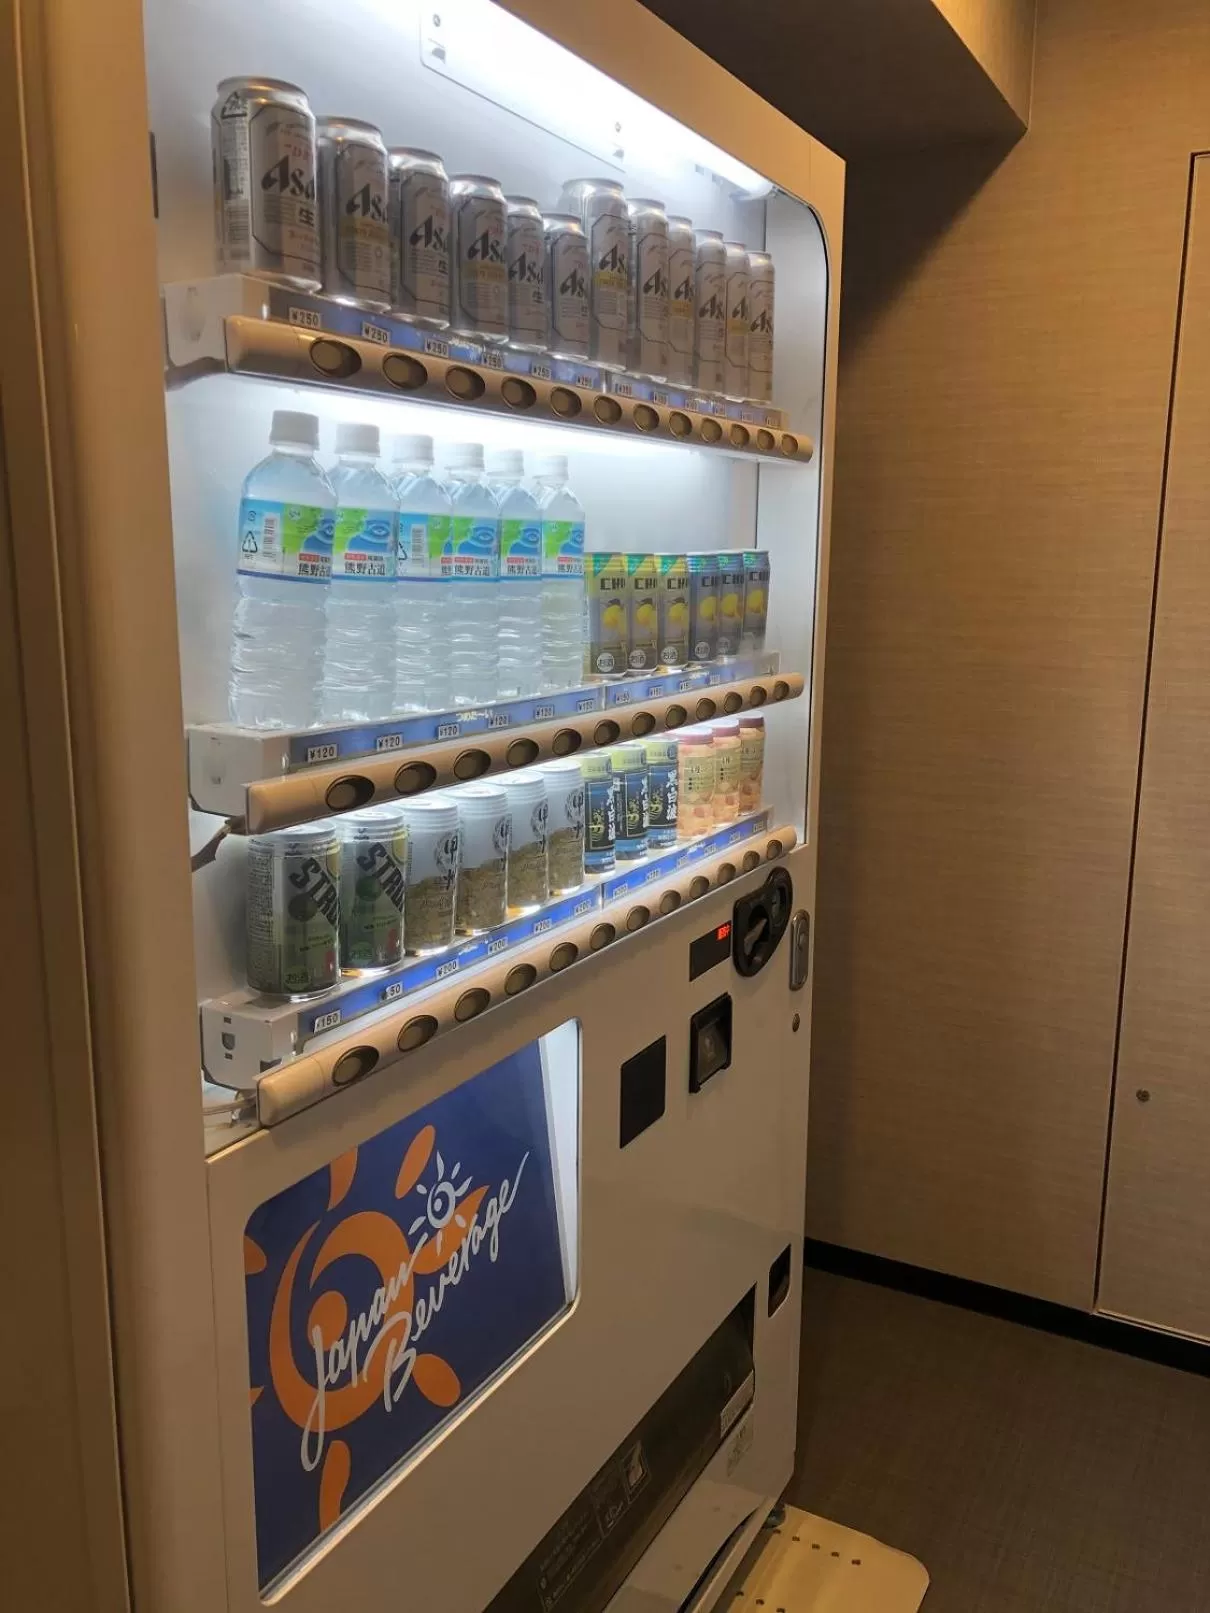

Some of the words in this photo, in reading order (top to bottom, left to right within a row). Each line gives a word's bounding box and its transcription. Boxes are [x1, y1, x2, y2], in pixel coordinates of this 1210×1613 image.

[293, 310, 318, 326] ¥250
[364, 326, 388, 343] ¥250
[427, 341, 448, 357] ¥250
[454, 564, 490, 577] 熊野古道
[439, 725, 458, 738] ¥120
[378, 736, 400, 749] ¥120
[310, 746, 335, 760] ¥120
[489, 938, 506, 952] ¥200
[438, 960, 457, 977] ¥200
[362, 1151, 530, 1413] Beverage
[300, 1233, 428, 1472] Japan
